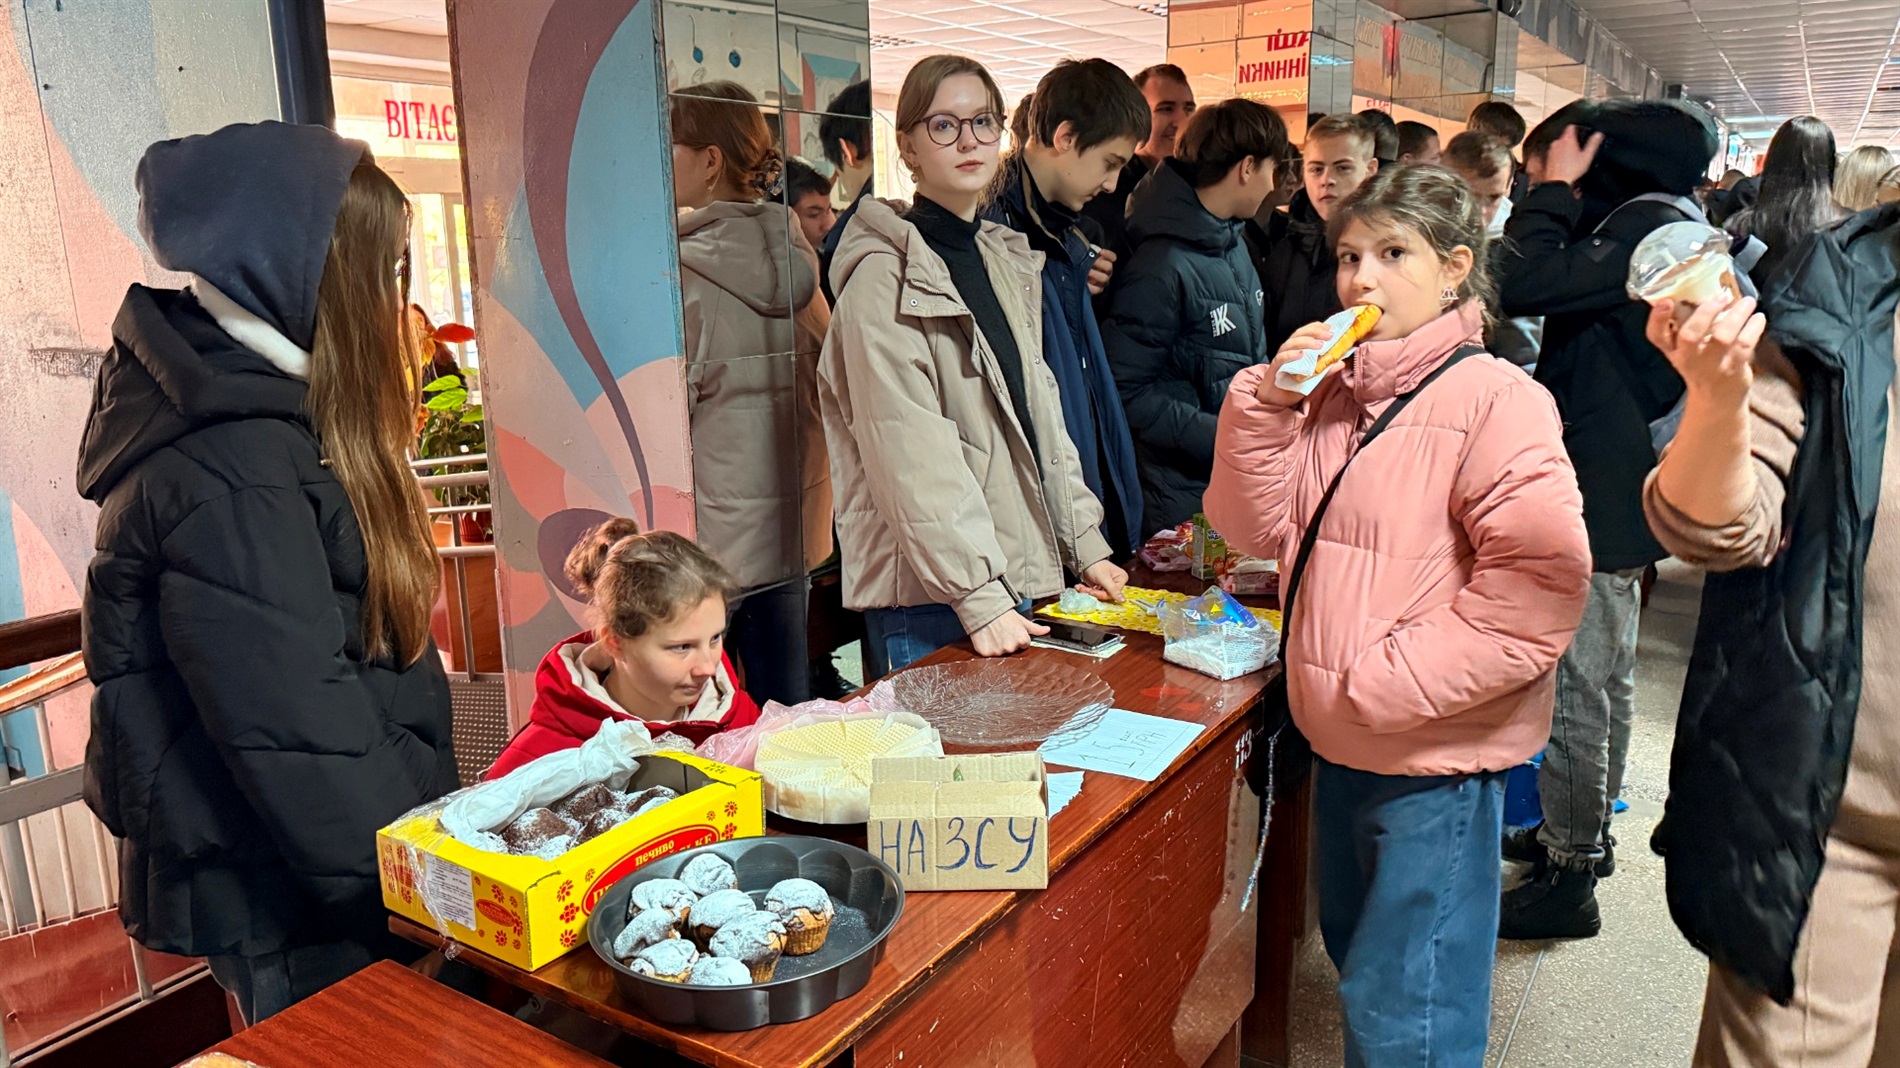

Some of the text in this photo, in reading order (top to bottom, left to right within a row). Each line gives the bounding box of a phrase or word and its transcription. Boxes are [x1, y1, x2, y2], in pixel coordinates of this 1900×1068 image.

[635, 840, 675, 867] печиво
[880, 816, 1038, 876] НА ЗСУ
